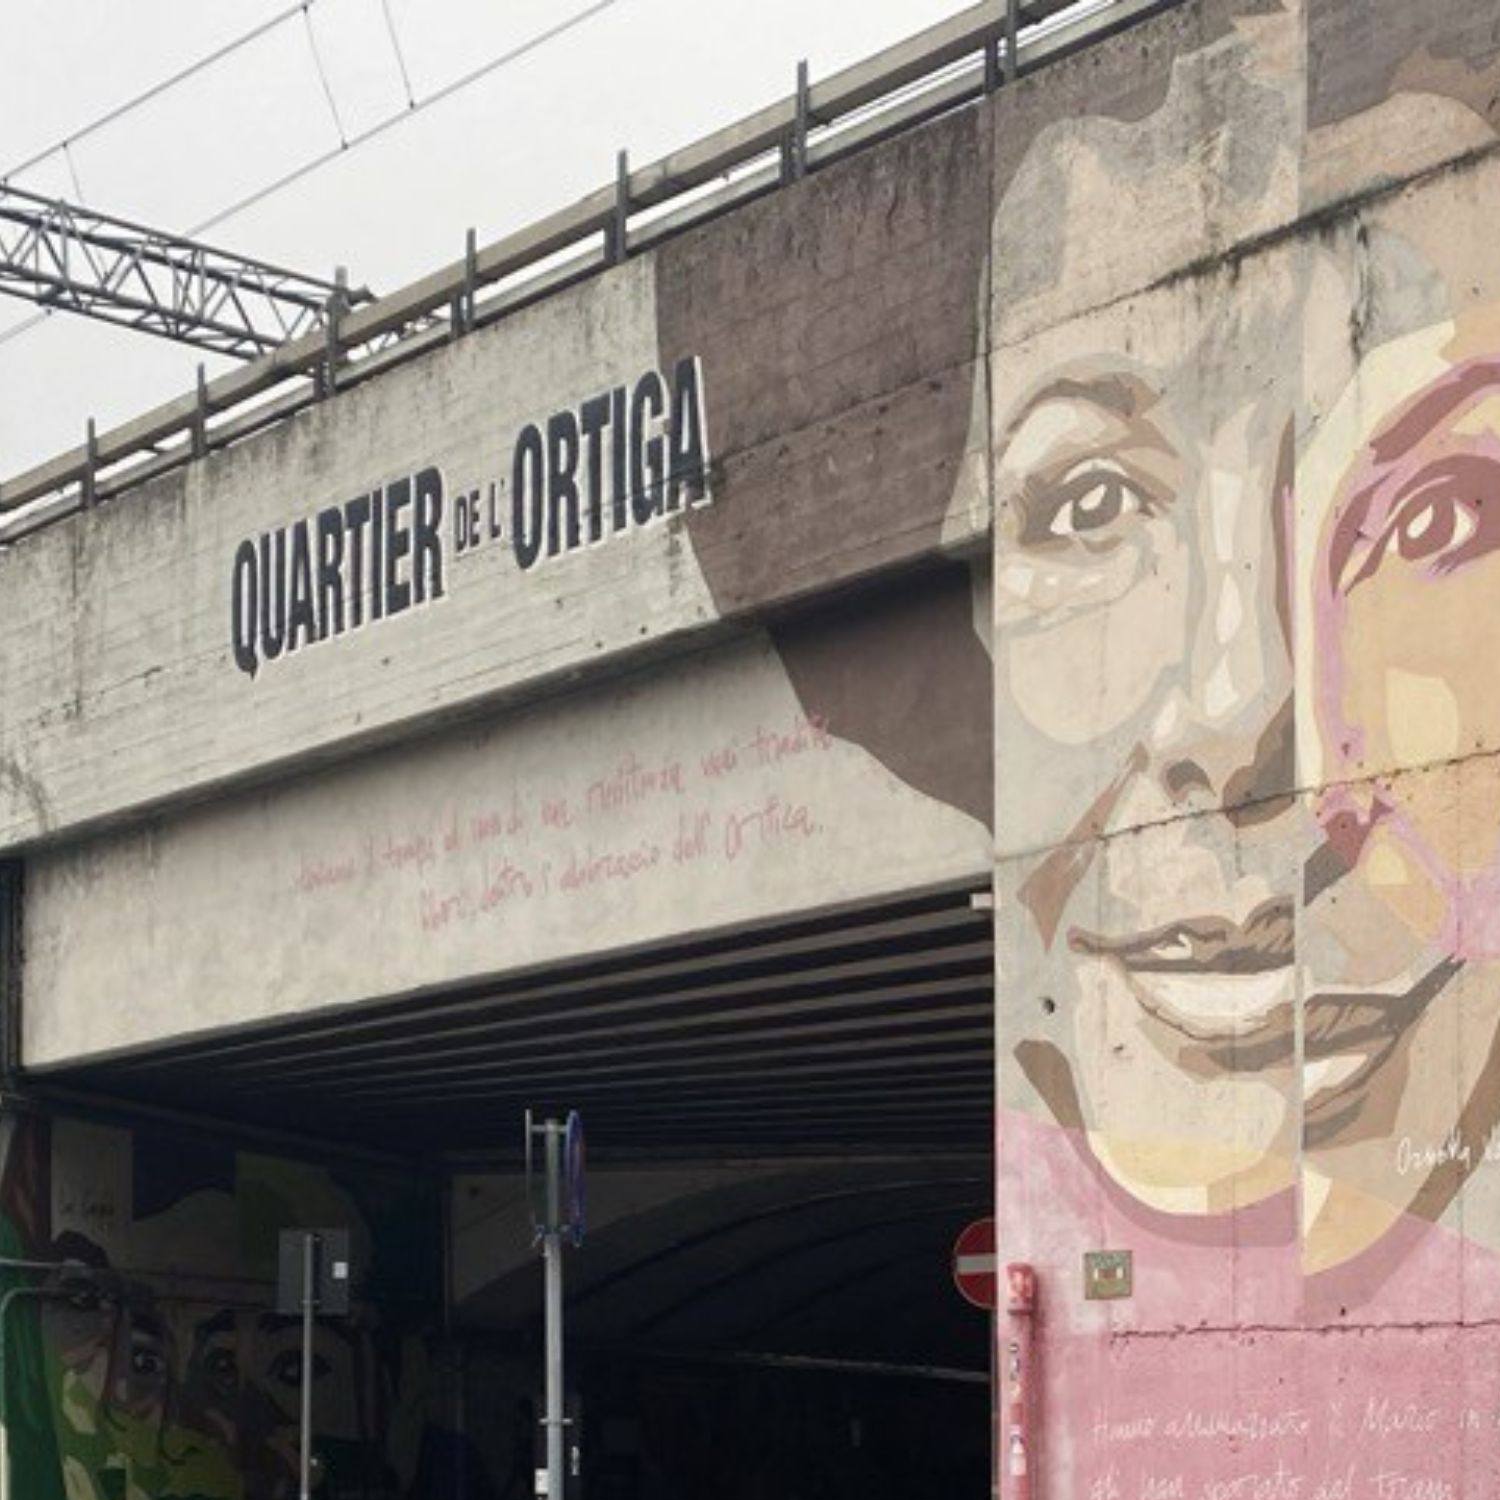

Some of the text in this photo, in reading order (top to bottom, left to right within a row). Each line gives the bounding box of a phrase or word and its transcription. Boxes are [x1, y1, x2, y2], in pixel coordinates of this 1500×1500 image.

[231, 465, 446, 679] QUARTIER
[455, 489, 481, 553] DE
[511, 354, 708, 570] ORTIGA
